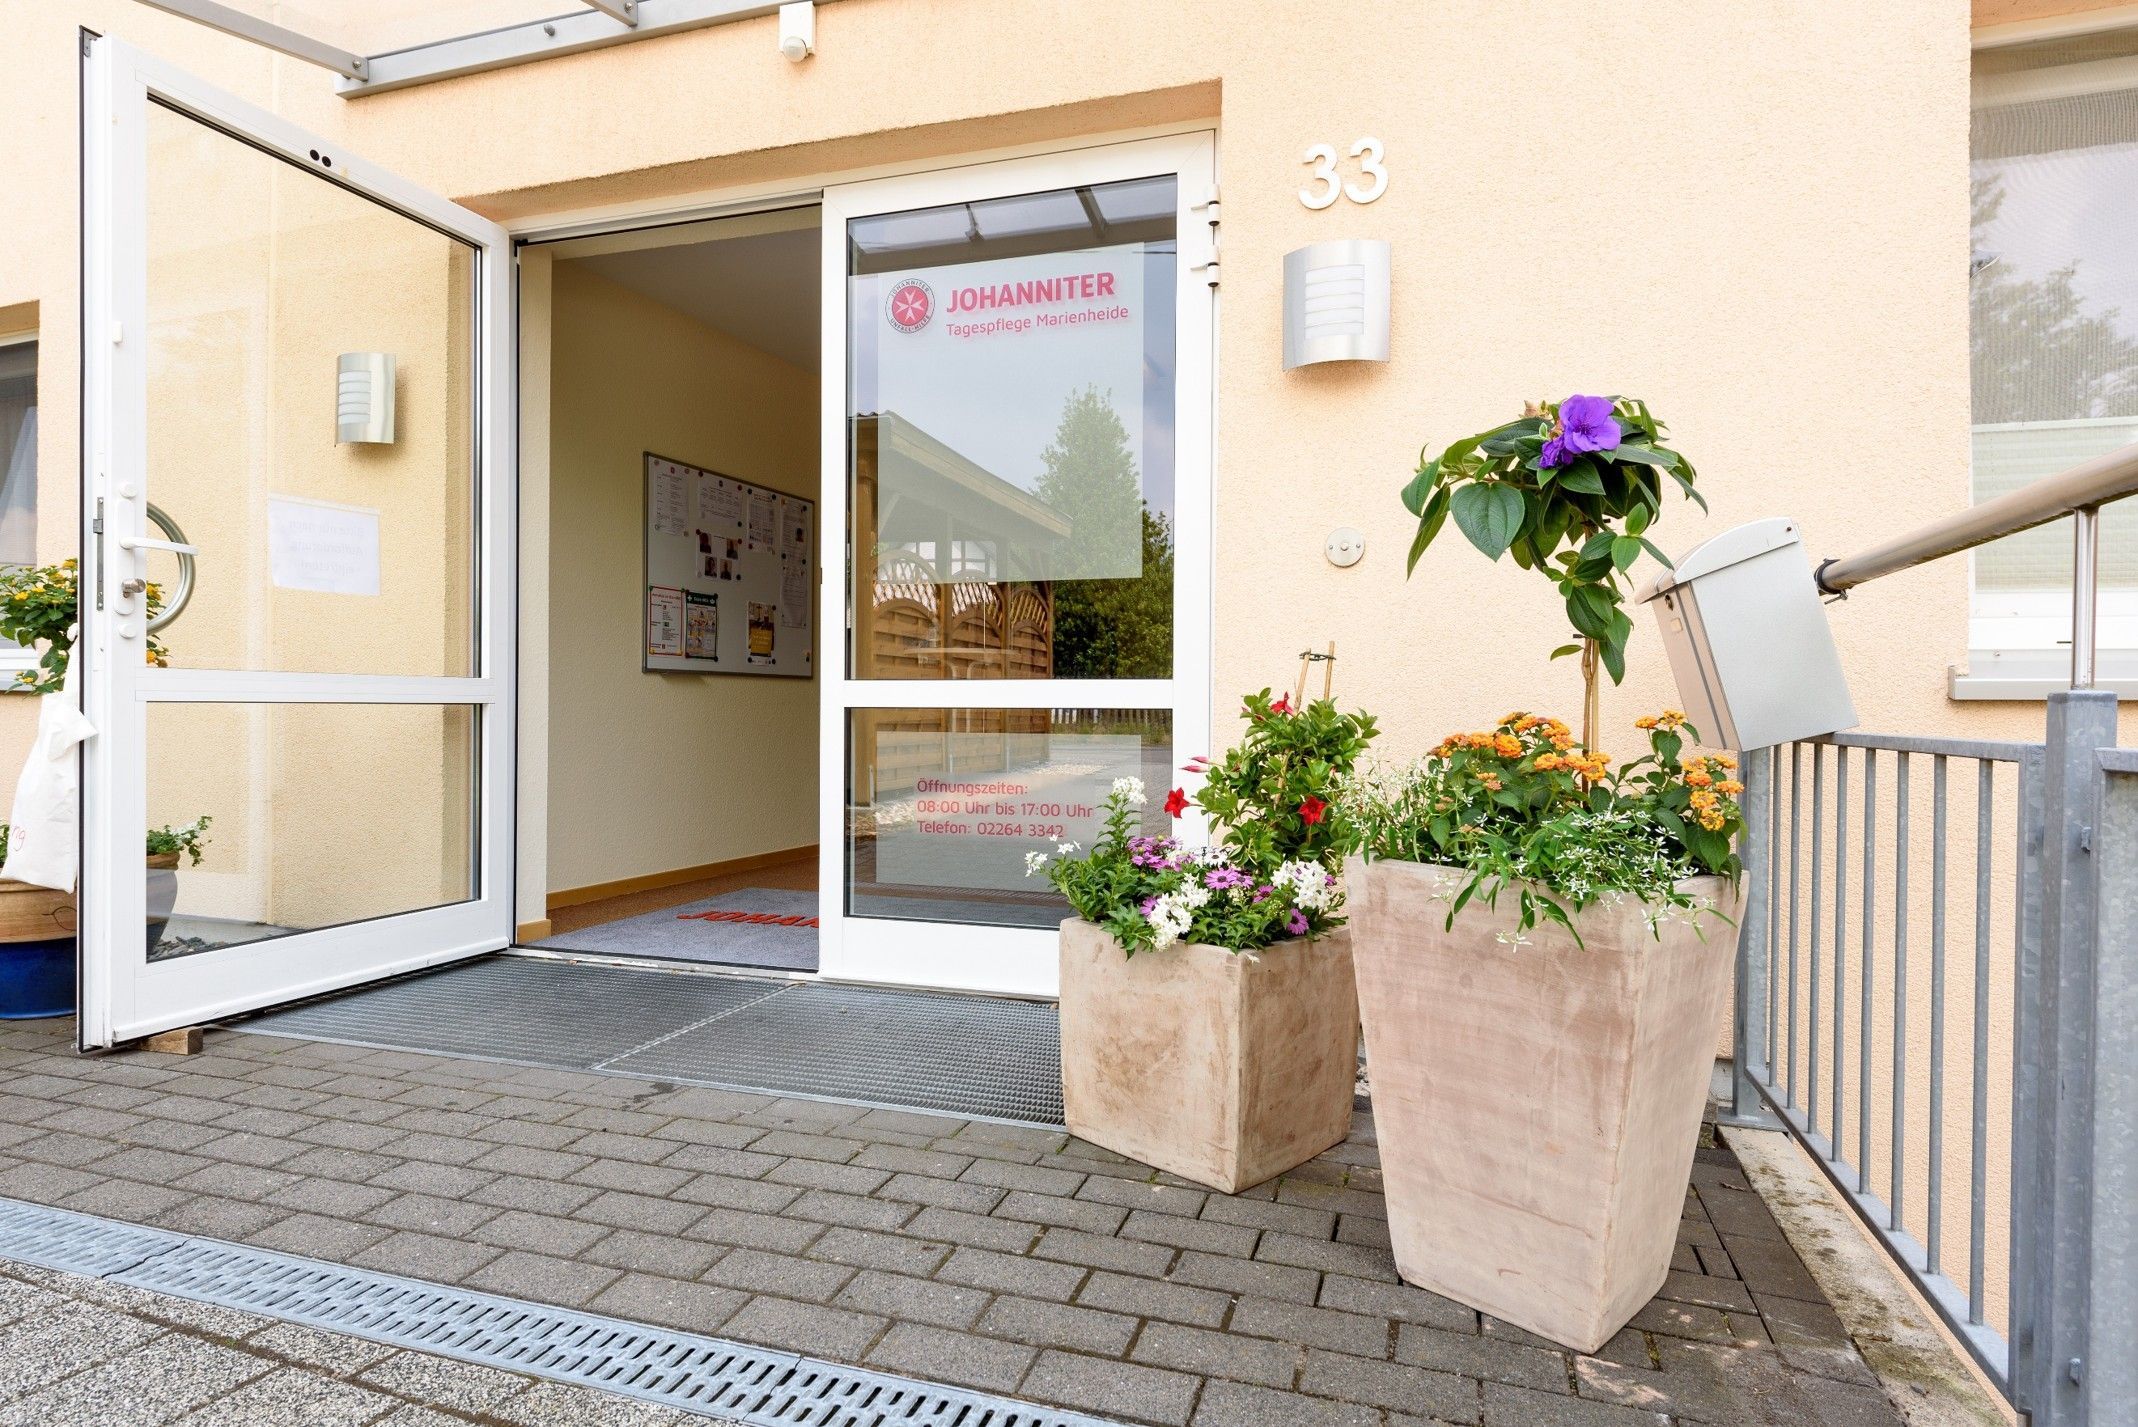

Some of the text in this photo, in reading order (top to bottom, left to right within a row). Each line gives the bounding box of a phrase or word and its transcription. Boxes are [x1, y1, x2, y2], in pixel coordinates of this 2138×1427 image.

[1298, 136, 1389, 210] 33
[946, 271, 1115, 313] JOHANNITER
[945, 305, 1129, 338] Tagespflege Marienheide
[917, 778, 1028, 796] Öffnungszeiten:
[916, 801, 1094, 818] 08:00 Uhr bis 17:00 Uhr
[916, 820, 1065, 839] Telefon: 02264 3342
